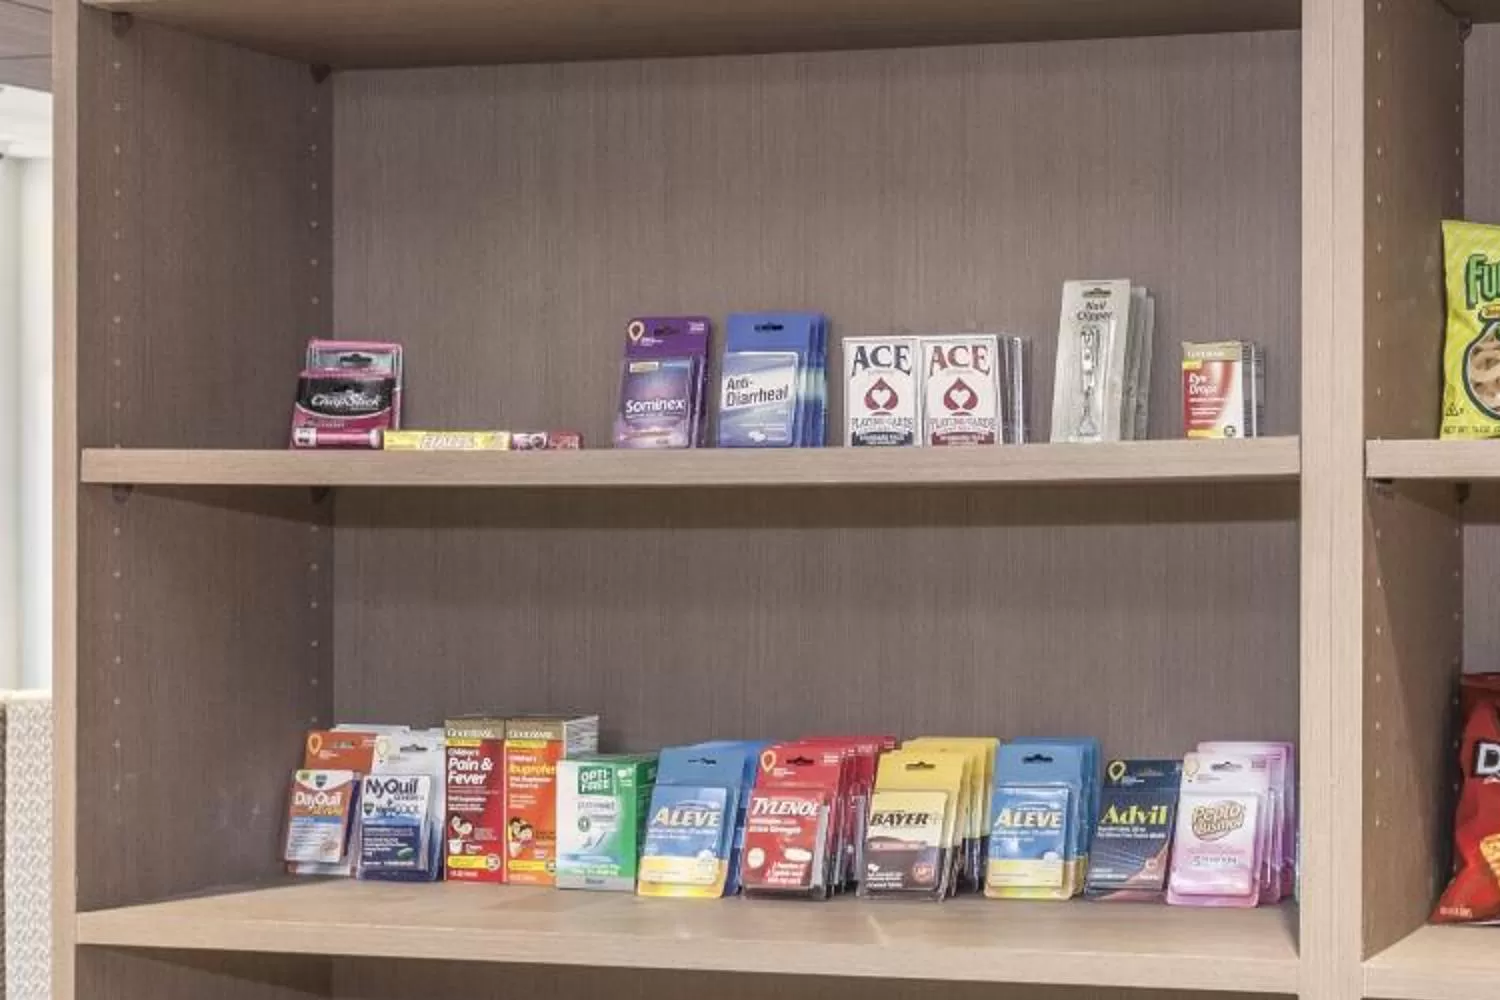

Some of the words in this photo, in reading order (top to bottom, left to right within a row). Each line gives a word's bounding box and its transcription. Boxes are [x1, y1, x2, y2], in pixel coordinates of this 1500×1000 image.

[851, 344, 913, 377] ACE
[929, 344, 991, 377] ACE
[726, 384, 789, 407] Diarrheal
[449, 757, 479, 771] Pain
[481, 757, 494, 771] &
[365, 778, 420, 798] NyQuil
[448, 770, 487, 785] Fever
[650, 806, 721, 827] ALEVE
[751, 796, 820, 817] TYLENOL
[1100, 803, 1168, 826] Advil
[869, 812, 930, 827] BAYER
[993, 806, 1063, 829] ALEVE
